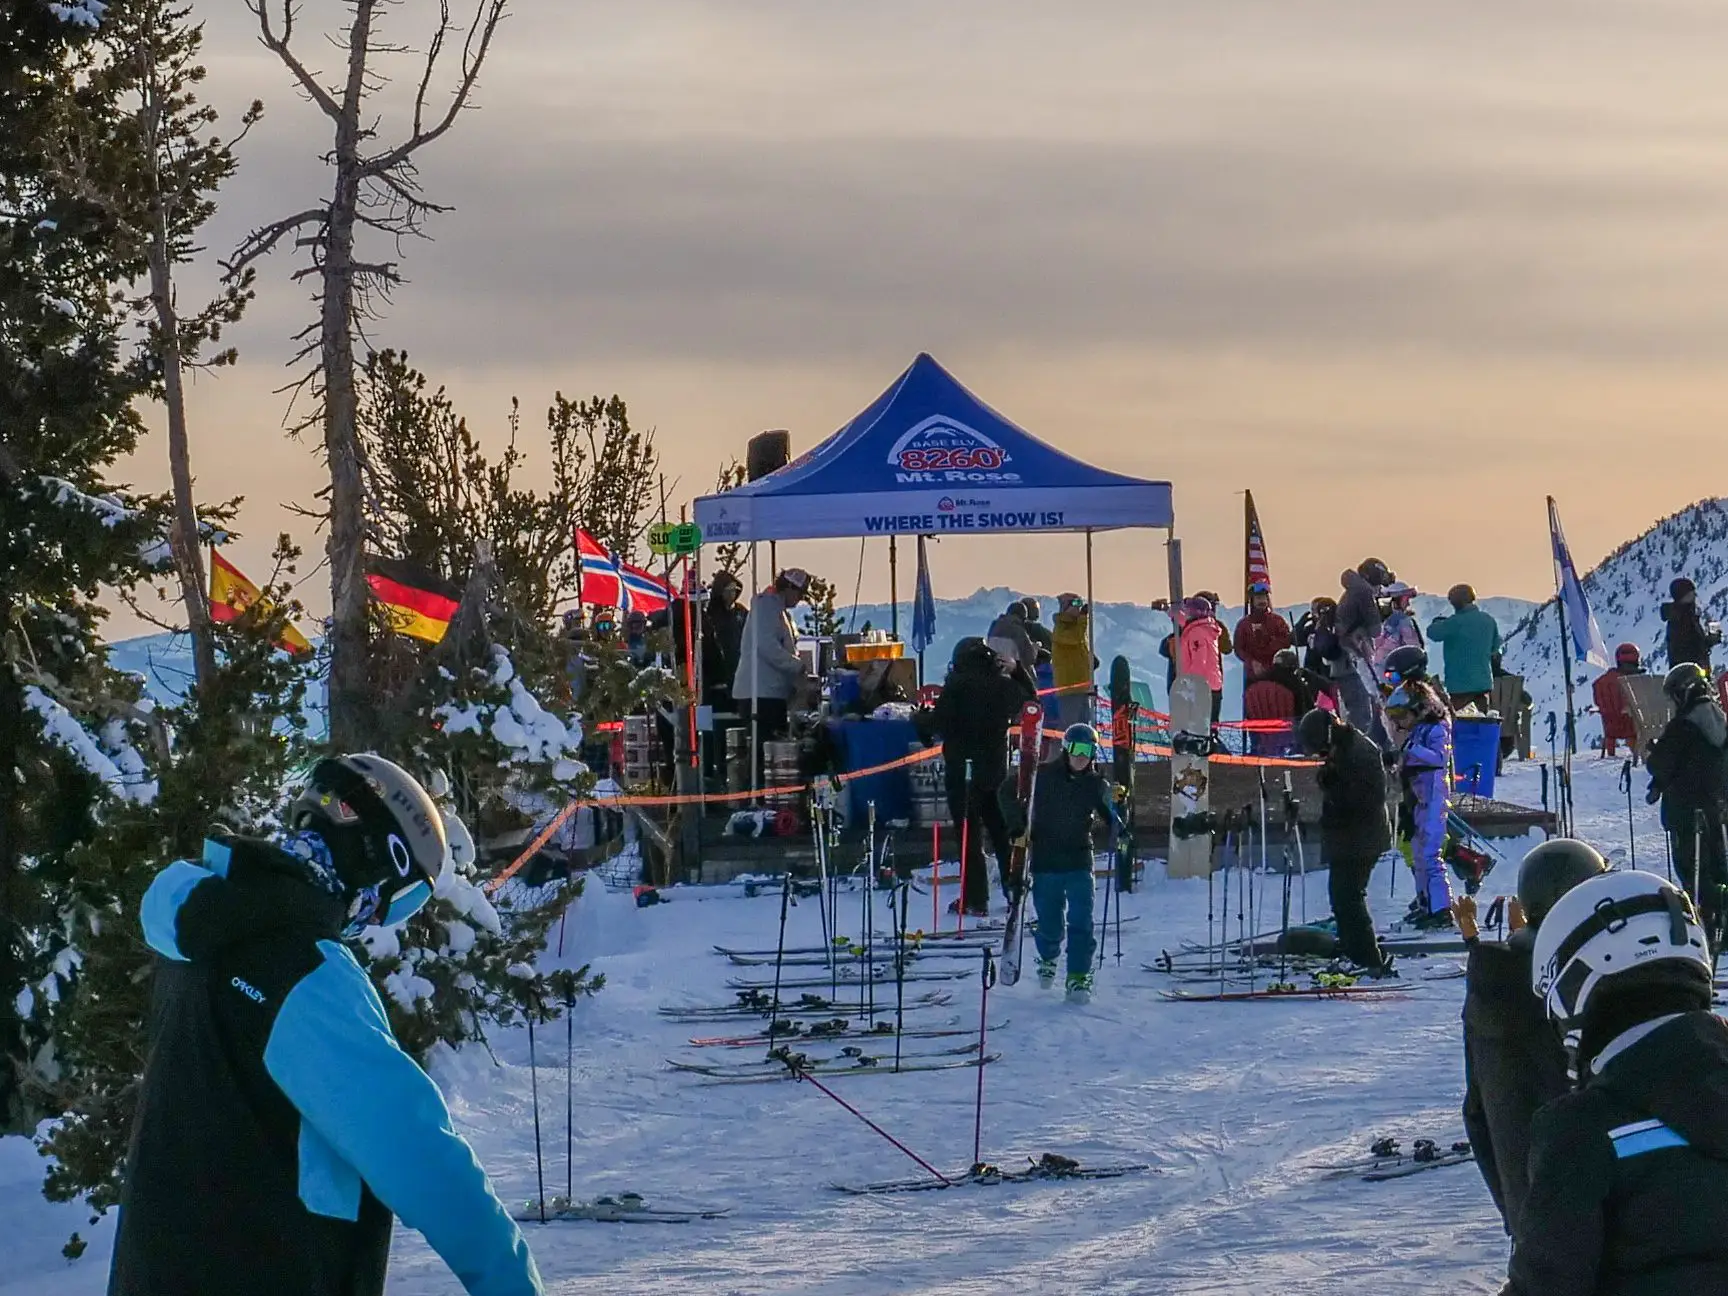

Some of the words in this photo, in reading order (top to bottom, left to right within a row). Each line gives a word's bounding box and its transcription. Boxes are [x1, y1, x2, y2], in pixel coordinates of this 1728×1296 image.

[912, 439, 948, 447] BASE
[950, 438, 978, 447] ELV.
[899, 447, 1007, 471] 8260'
[895, 472, 942, 483] Mt.
[945, 470, 1021, 482] Rose
[864, 515, 933, 531] WHERE
[937, 513, 974, 529] THE
[976, 512, 1036, 528] SNOW
[1040, 511, 1064, 526] IS!
[650, 531, 672, 545] SLO
[1634, 947, 1659, 959] SMITH
